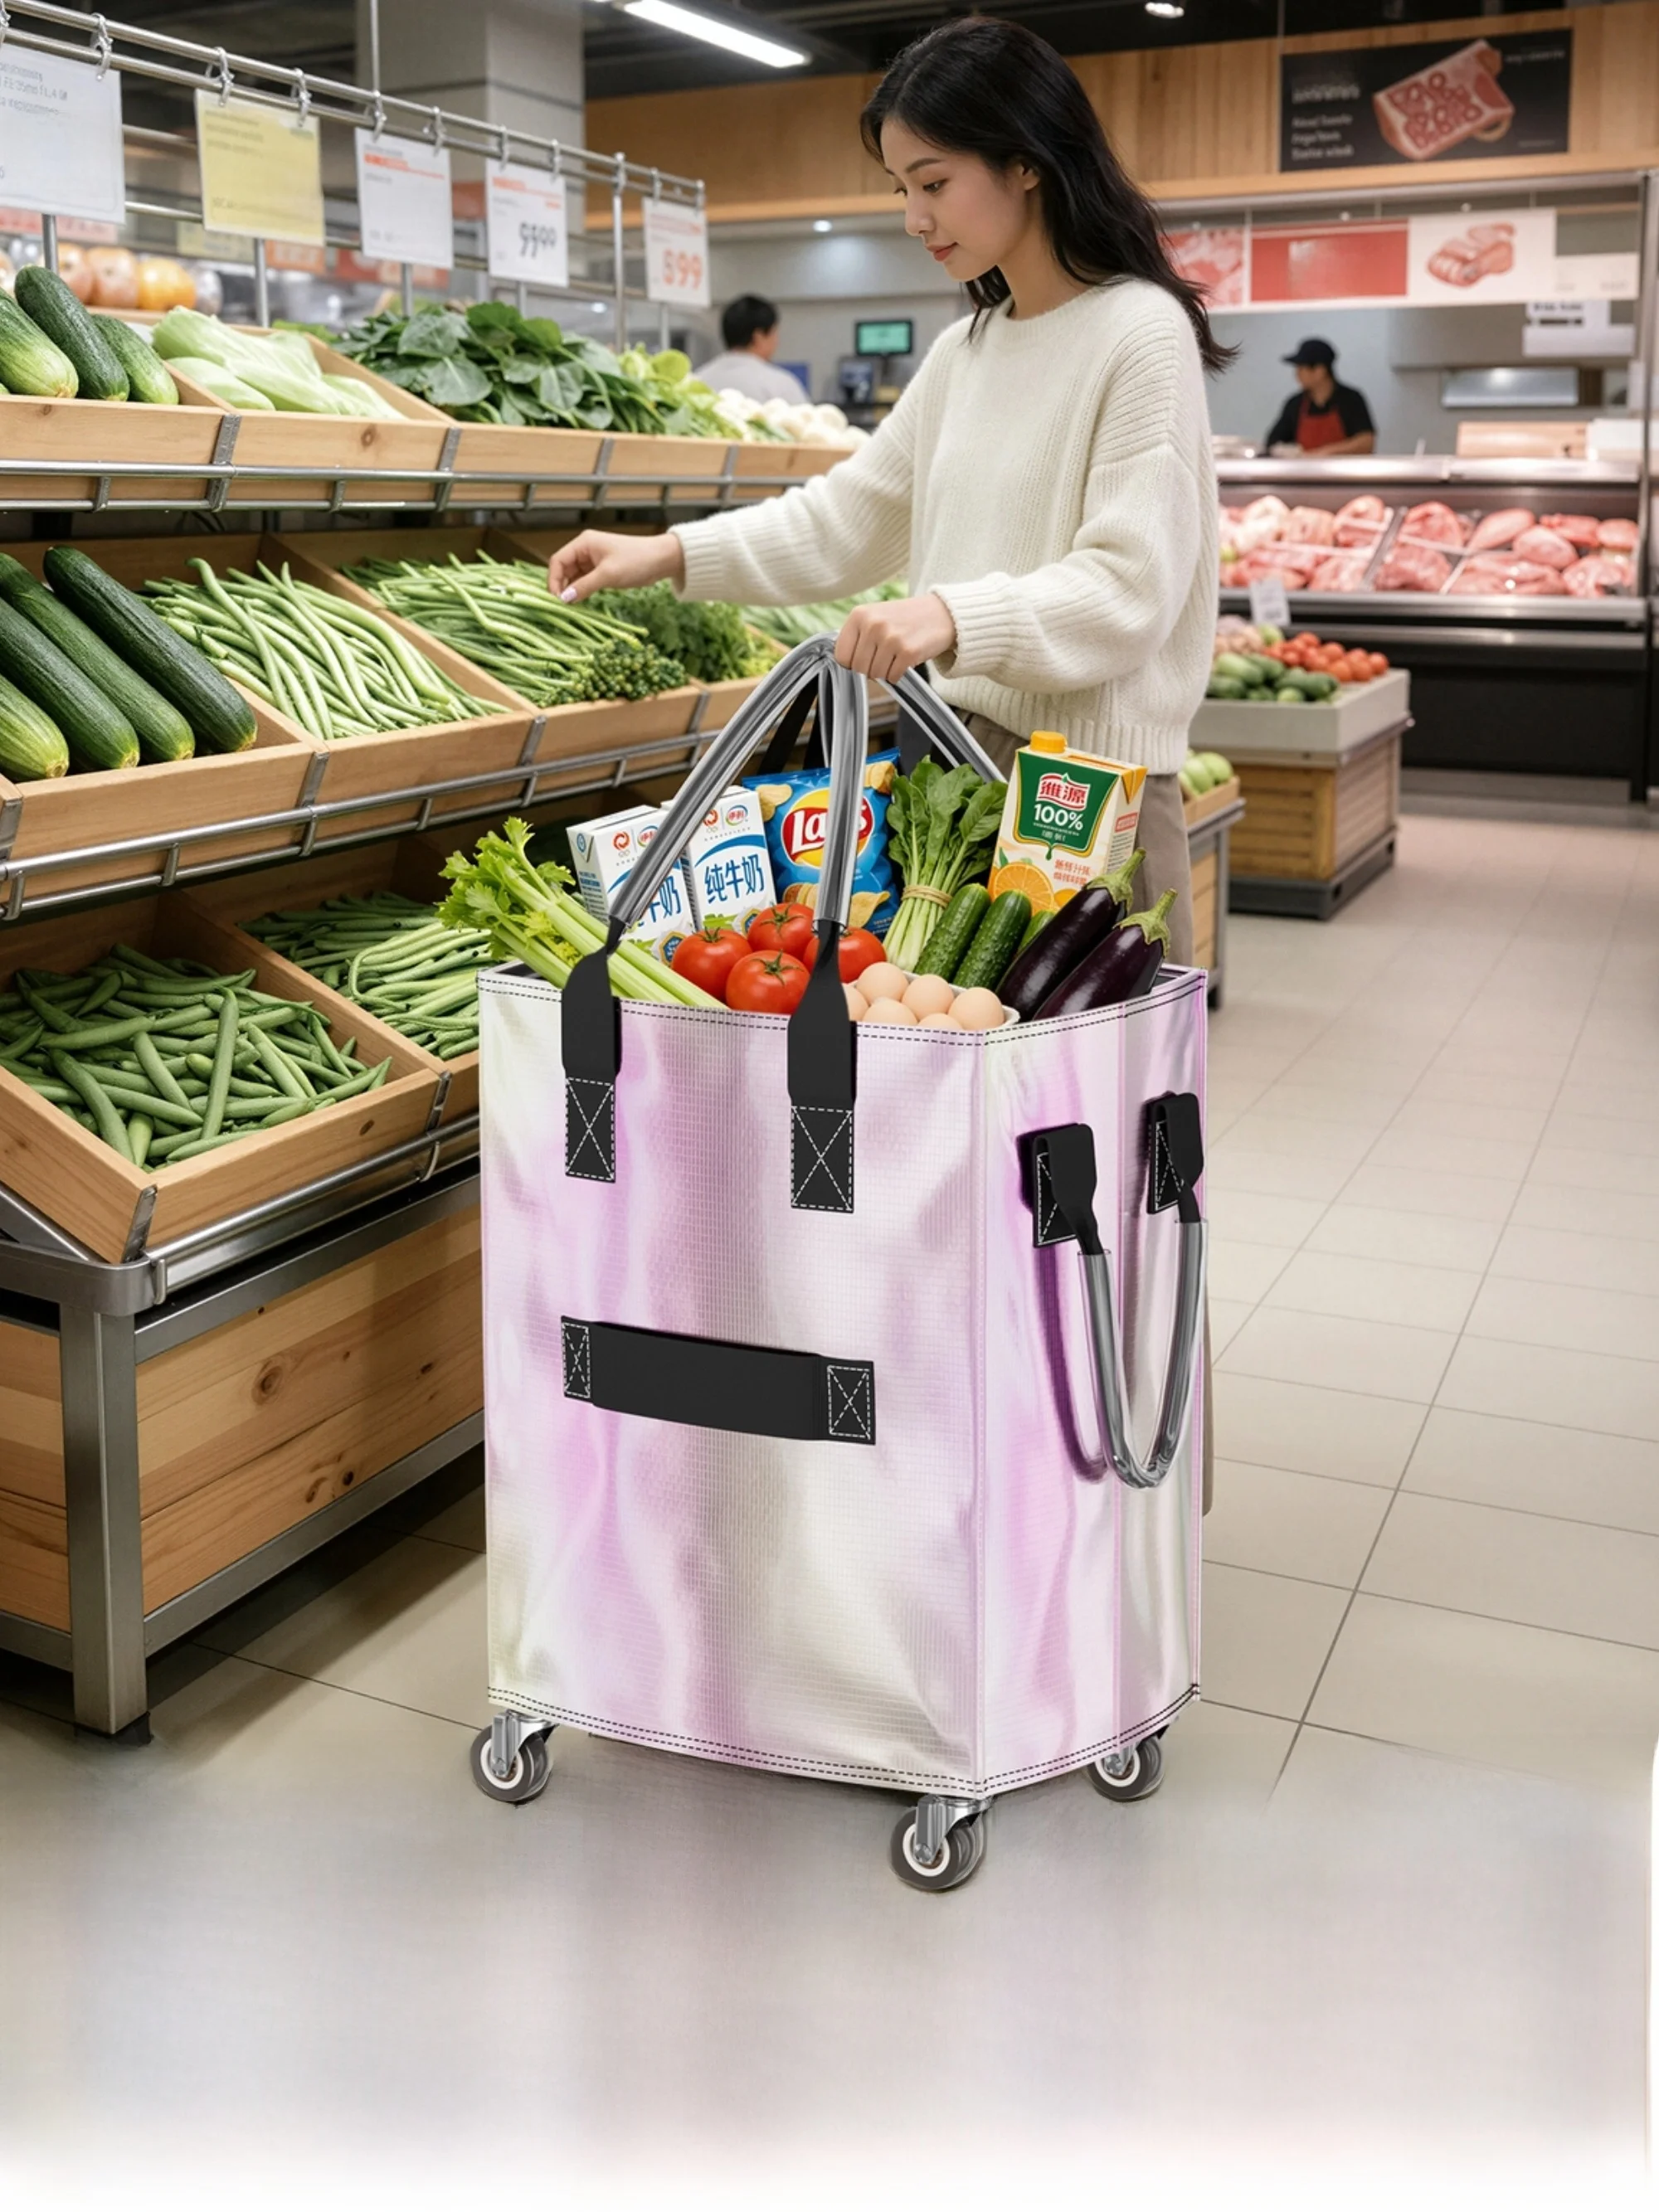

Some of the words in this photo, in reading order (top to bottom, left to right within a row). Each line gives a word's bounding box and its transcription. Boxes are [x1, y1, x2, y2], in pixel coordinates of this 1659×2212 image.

[1034, 804, 1083, 830] 100%
[704, 853, 765, 904] 纯牛奶
